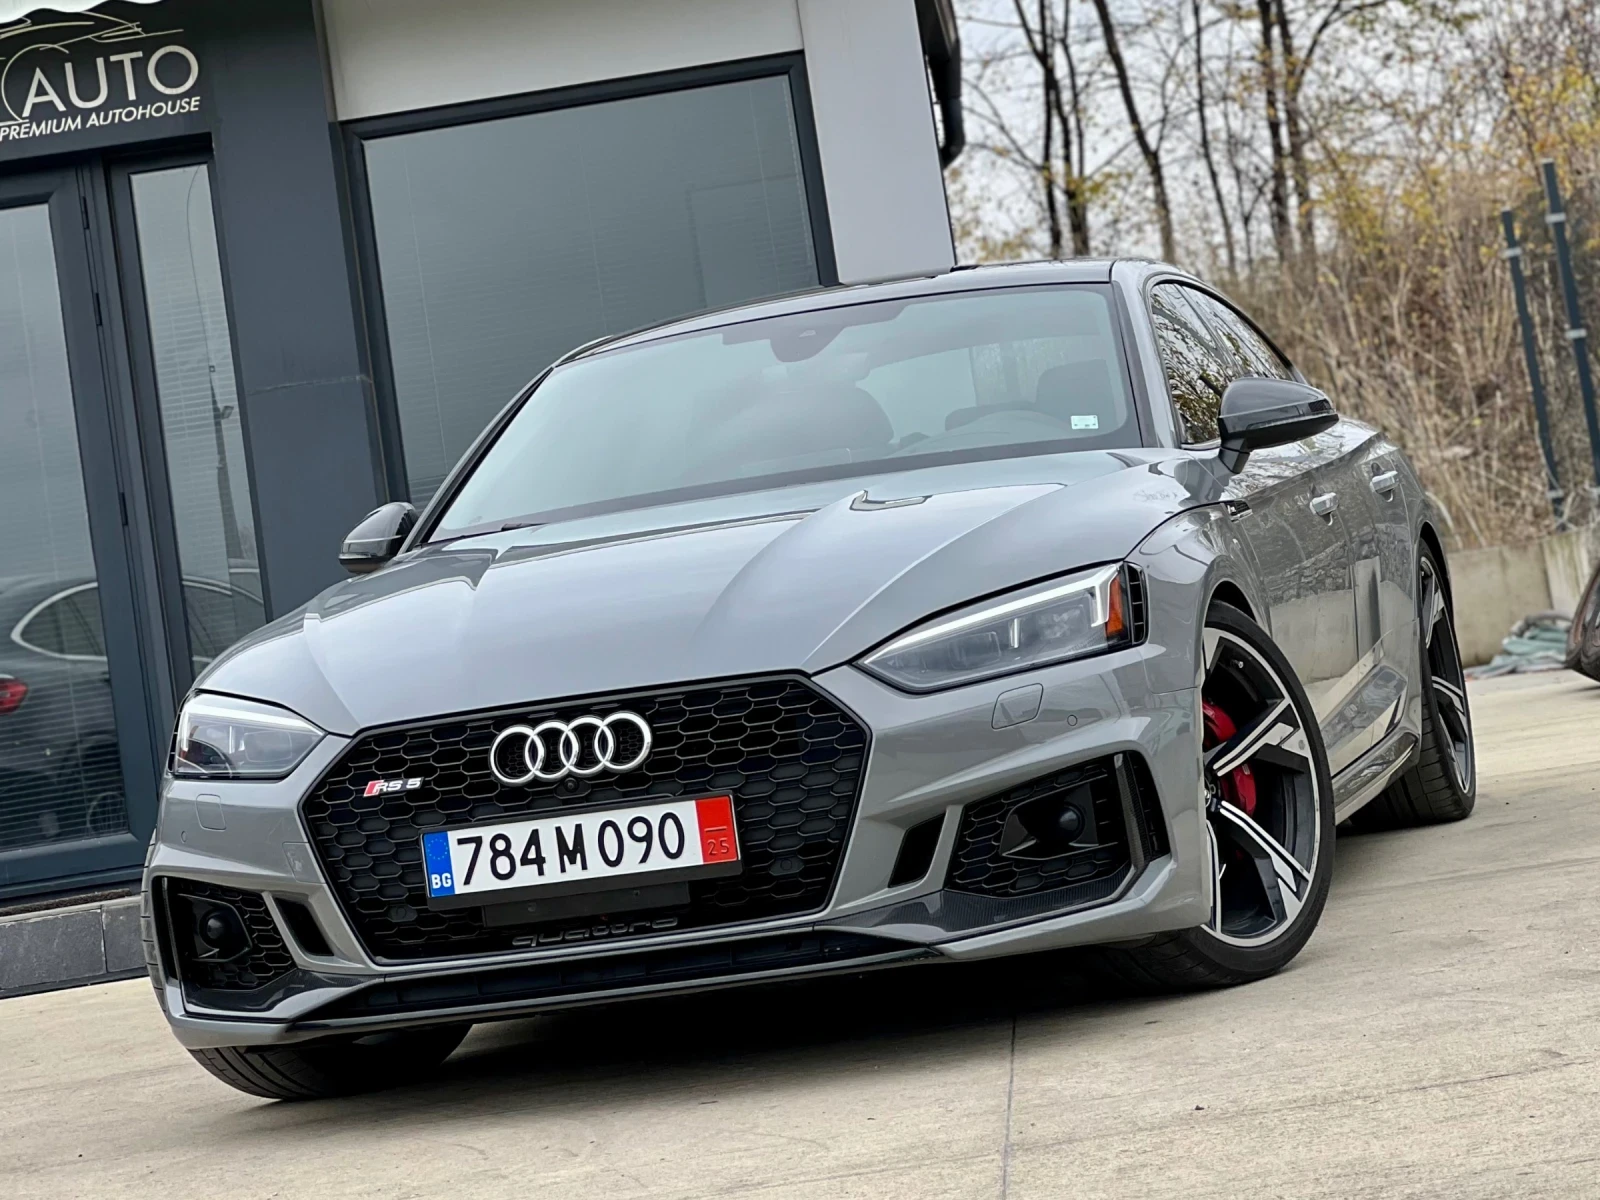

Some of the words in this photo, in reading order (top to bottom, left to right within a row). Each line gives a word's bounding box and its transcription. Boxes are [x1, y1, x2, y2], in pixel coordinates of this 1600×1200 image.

[22, 45, 199, 118] AUTO
[0, 114, 81, 141] PREMIUM
[86, 96, 201, 128] AUTOHOUSE
[368, 780, 403, 796] RS
[406, 778, 422, 789] 5
[707, 837, 730, 856] 25
[431, 872, 452, 889] BG
[511, 917, 678, 947] quattro
